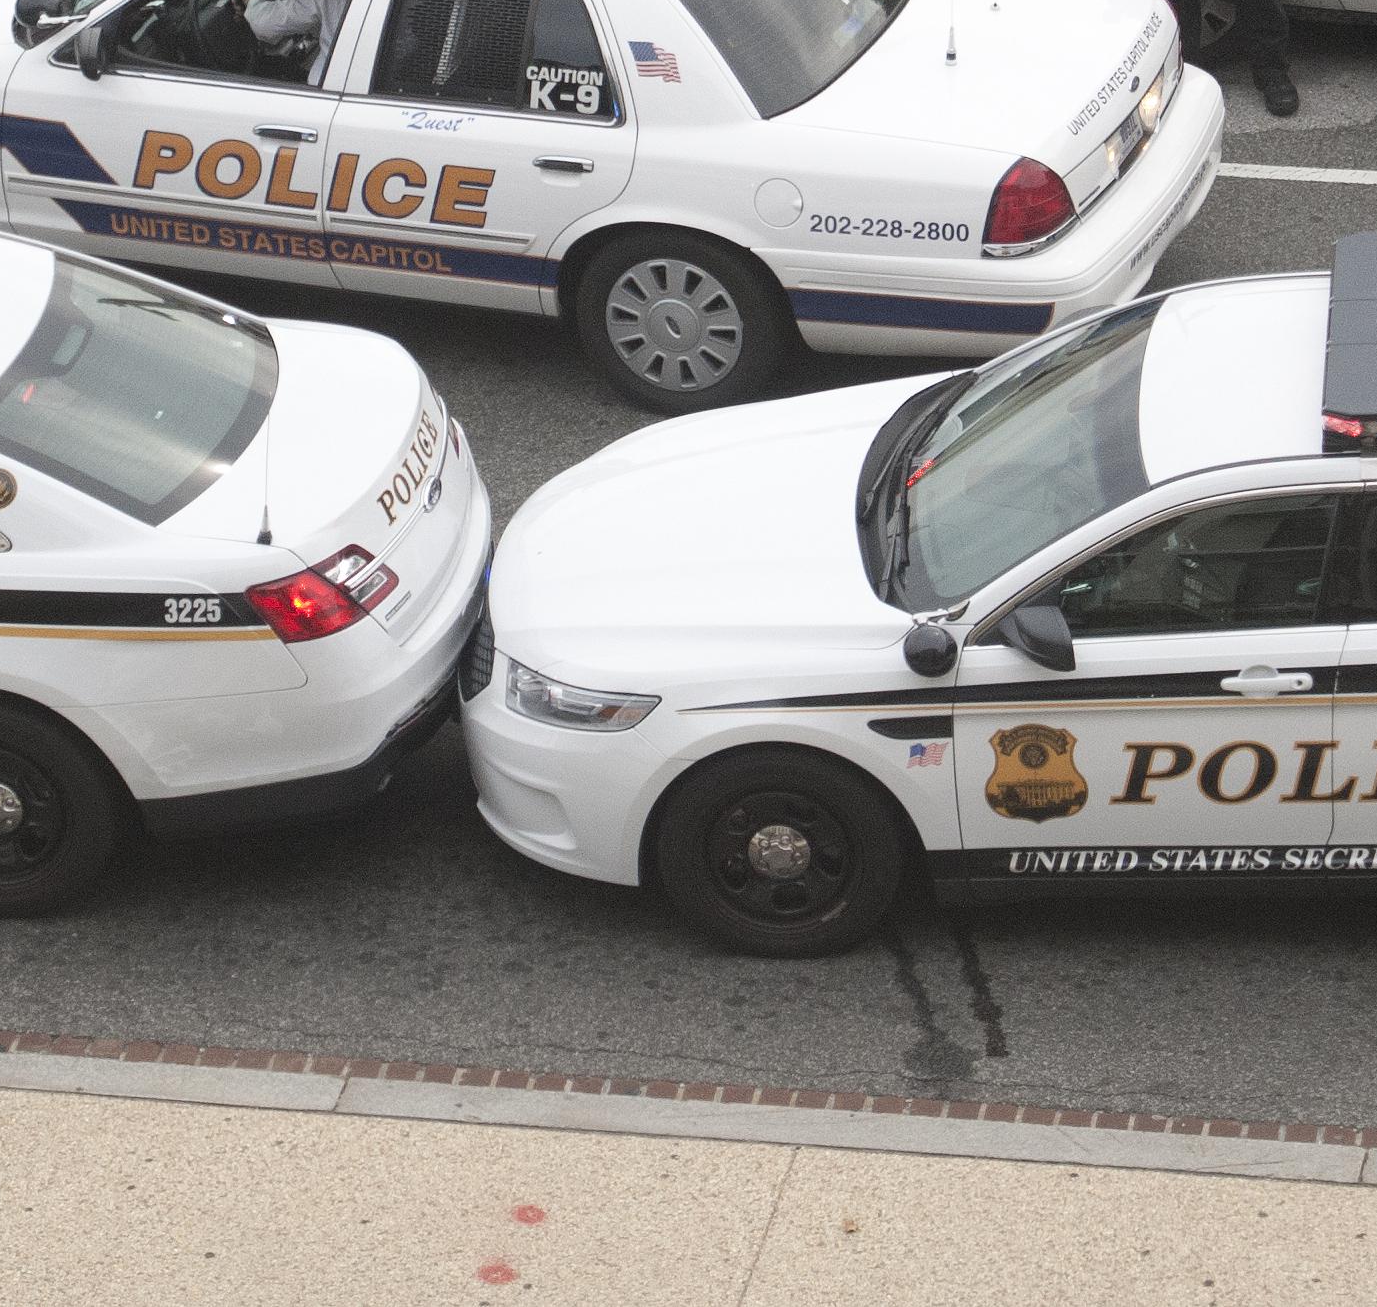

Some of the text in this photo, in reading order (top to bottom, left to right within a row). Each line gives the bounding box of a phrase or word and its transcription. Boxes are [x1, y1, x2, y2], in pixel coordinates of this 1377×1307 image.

[526, 65, 604, 87] CAUTION
[1067, 102, 1101, 137] UNITED
[1098, 67, 1129, 107] STATES
[1124, 36, 1148, 73] CAPITOL
[1142, 10, 1163, 41] POLICE
[529, 79, 601, 115] K-9
[132, 128, 496, 229] POLICE
[110, 212, 453, 273] UNITED STATES CAPITOL
[809, 212, 970, 244] 202-228-2800
[376, 408, 438, 526] POLICE
[163, 598, 222, 624] 3225
[1008, 848, 1139, 874] UNITED
[1148, 847, 1271, 872] STATES
